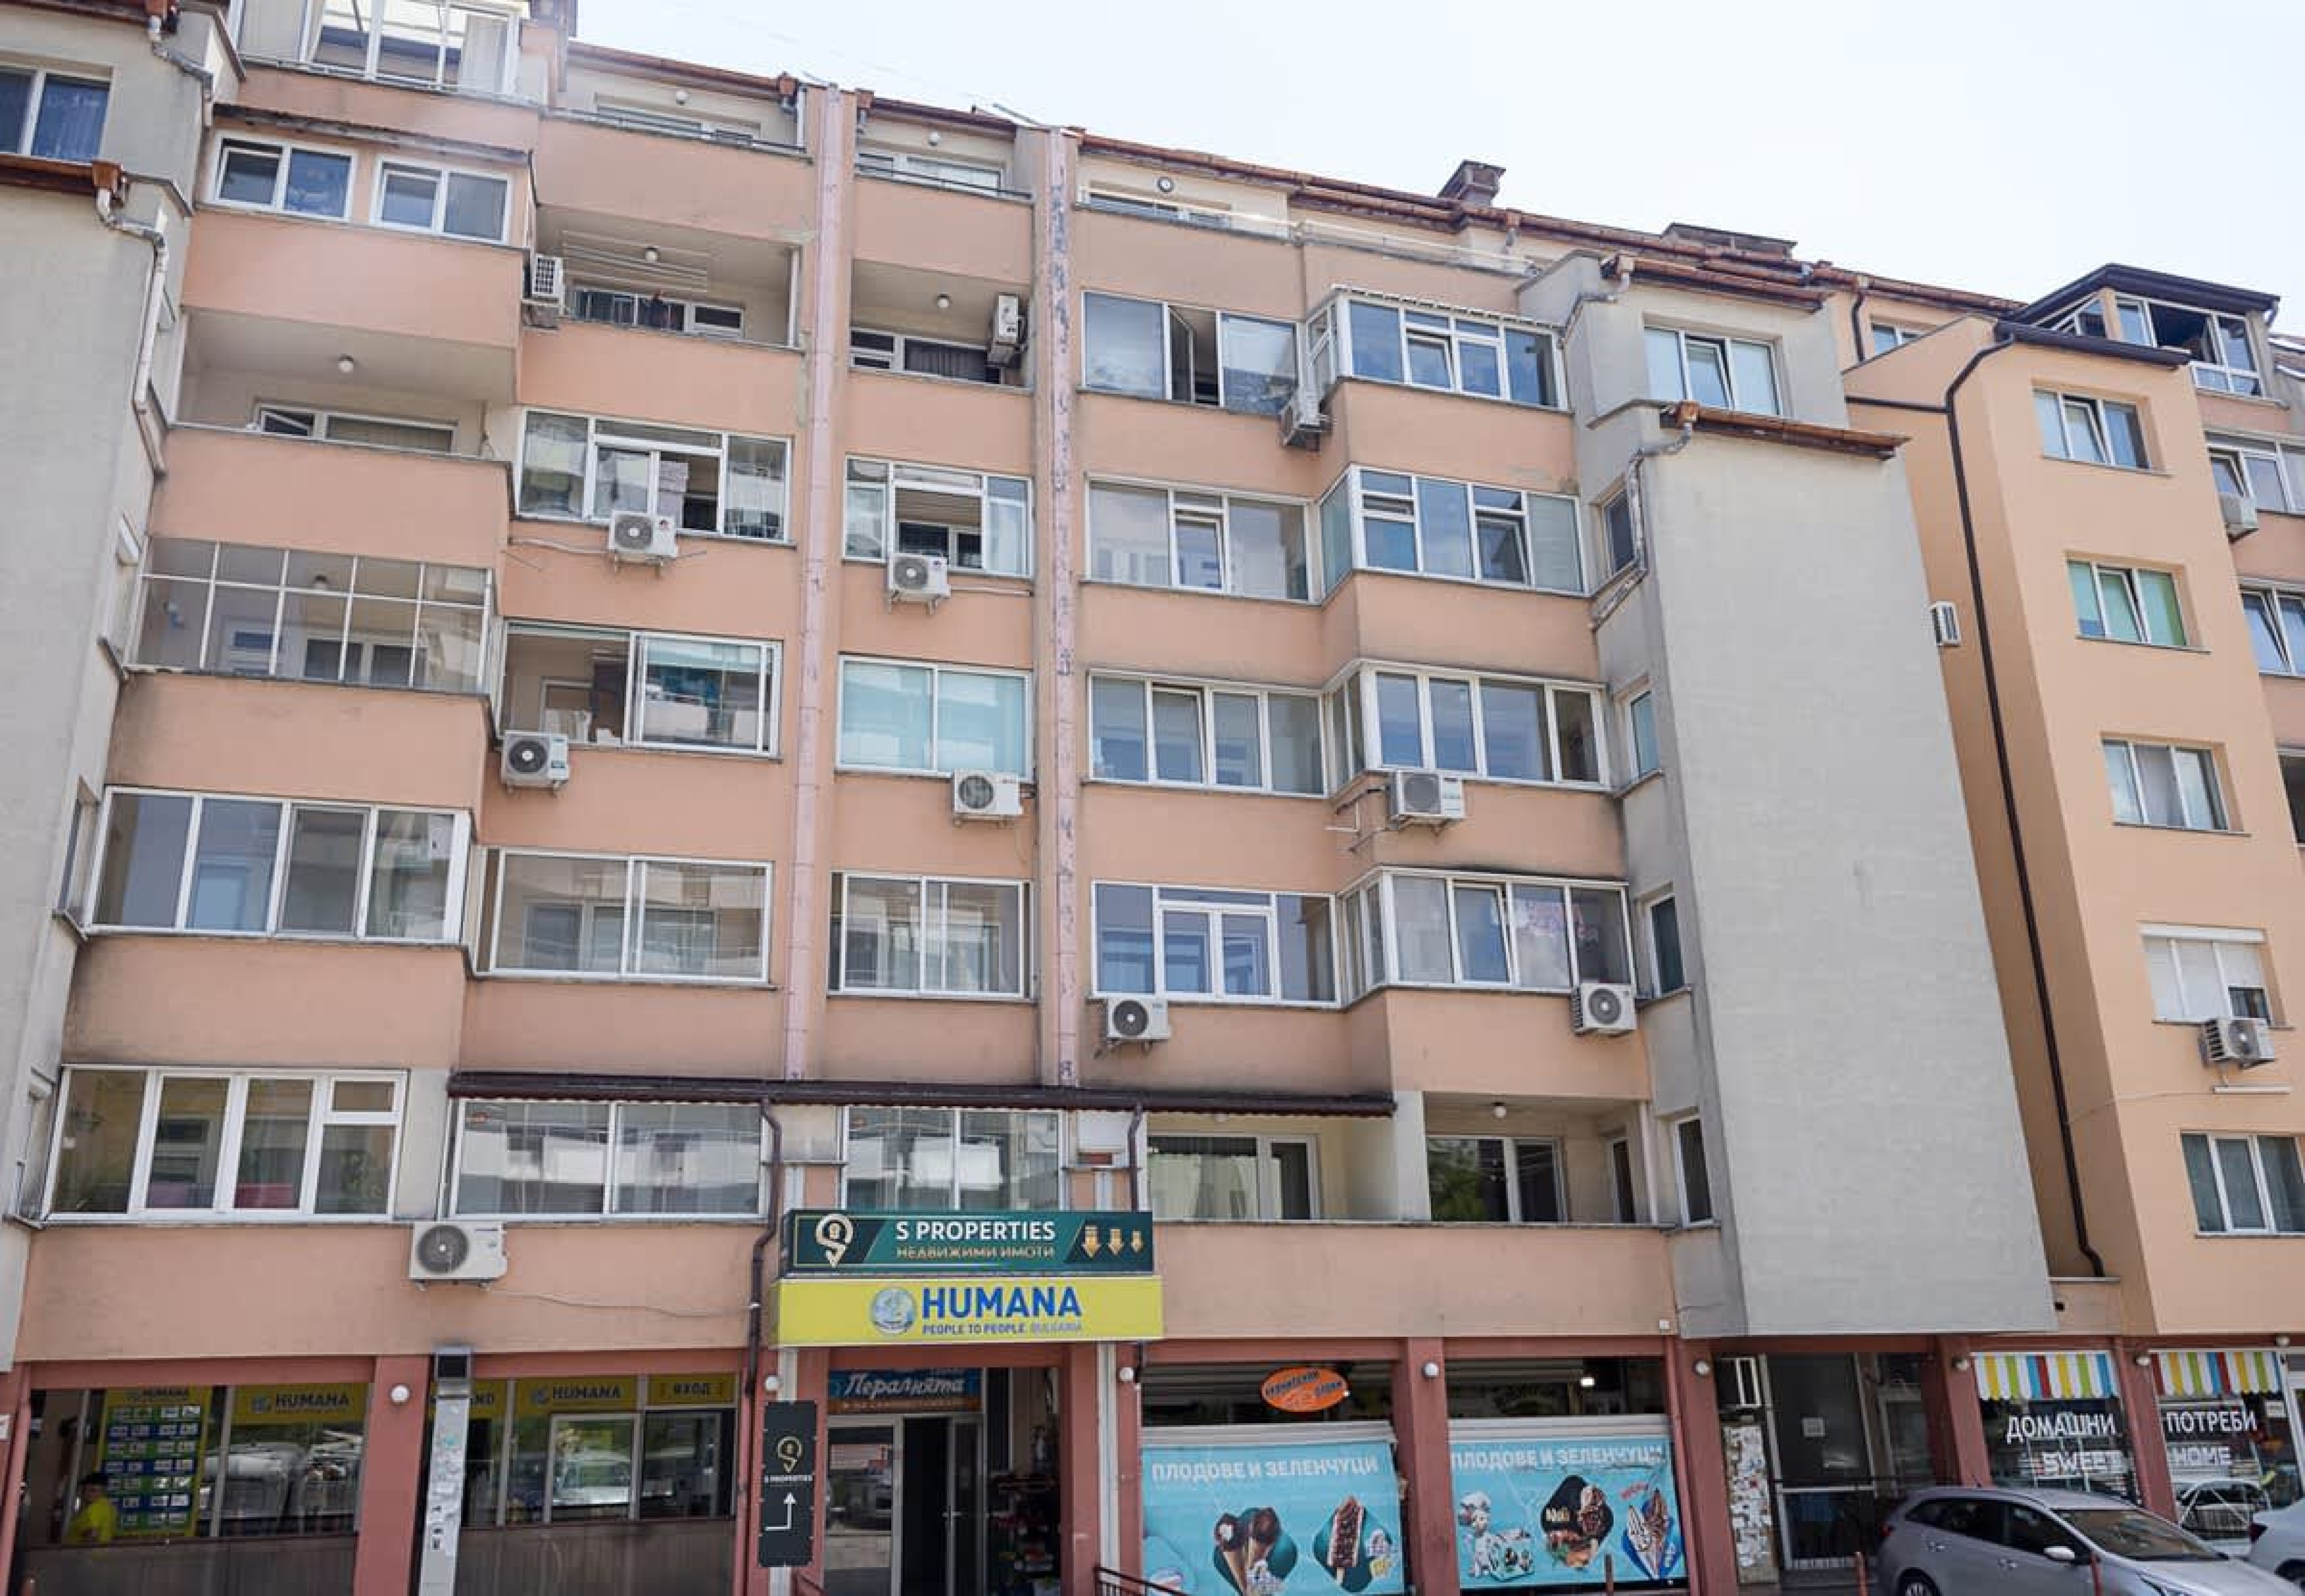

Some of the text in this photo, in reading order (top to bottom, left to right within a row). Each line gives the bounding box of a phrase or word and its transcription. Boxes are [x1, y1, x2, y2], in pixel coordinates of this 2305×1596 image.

[896, 1221, 1055, 1239] S PROPERTIES
[897, 1246, 1055, 1259] НЕДВИЖИМИ ИМОТИ
[923, 1287, 1081, 1318] HUMANA
[923, 1325, 963, 1334] PEOPLE
[969, 1324, 981, 1334] TO
[984, 1324, 1024, 1334] PEOPLE
[276, 1393, 349, 1407] HUMANA
[552, 1385, 621, 1400] HUMANA
[2006, 1411, 2116, 1444] ДОМАШНИ
[2166, 1411, 2257, 1433] ПОТРЕБИ
[1451, 1449, 1537, 1470] ПЛОДОВЕ
[2042, 1450, 2123, 1474] SWEET
[2170, 1447, 2232, 1465] HOME
[1152, 1455, 1378, 1483] ПЛОДОВЕ И ЗЕЛЕНЧУЦИ
